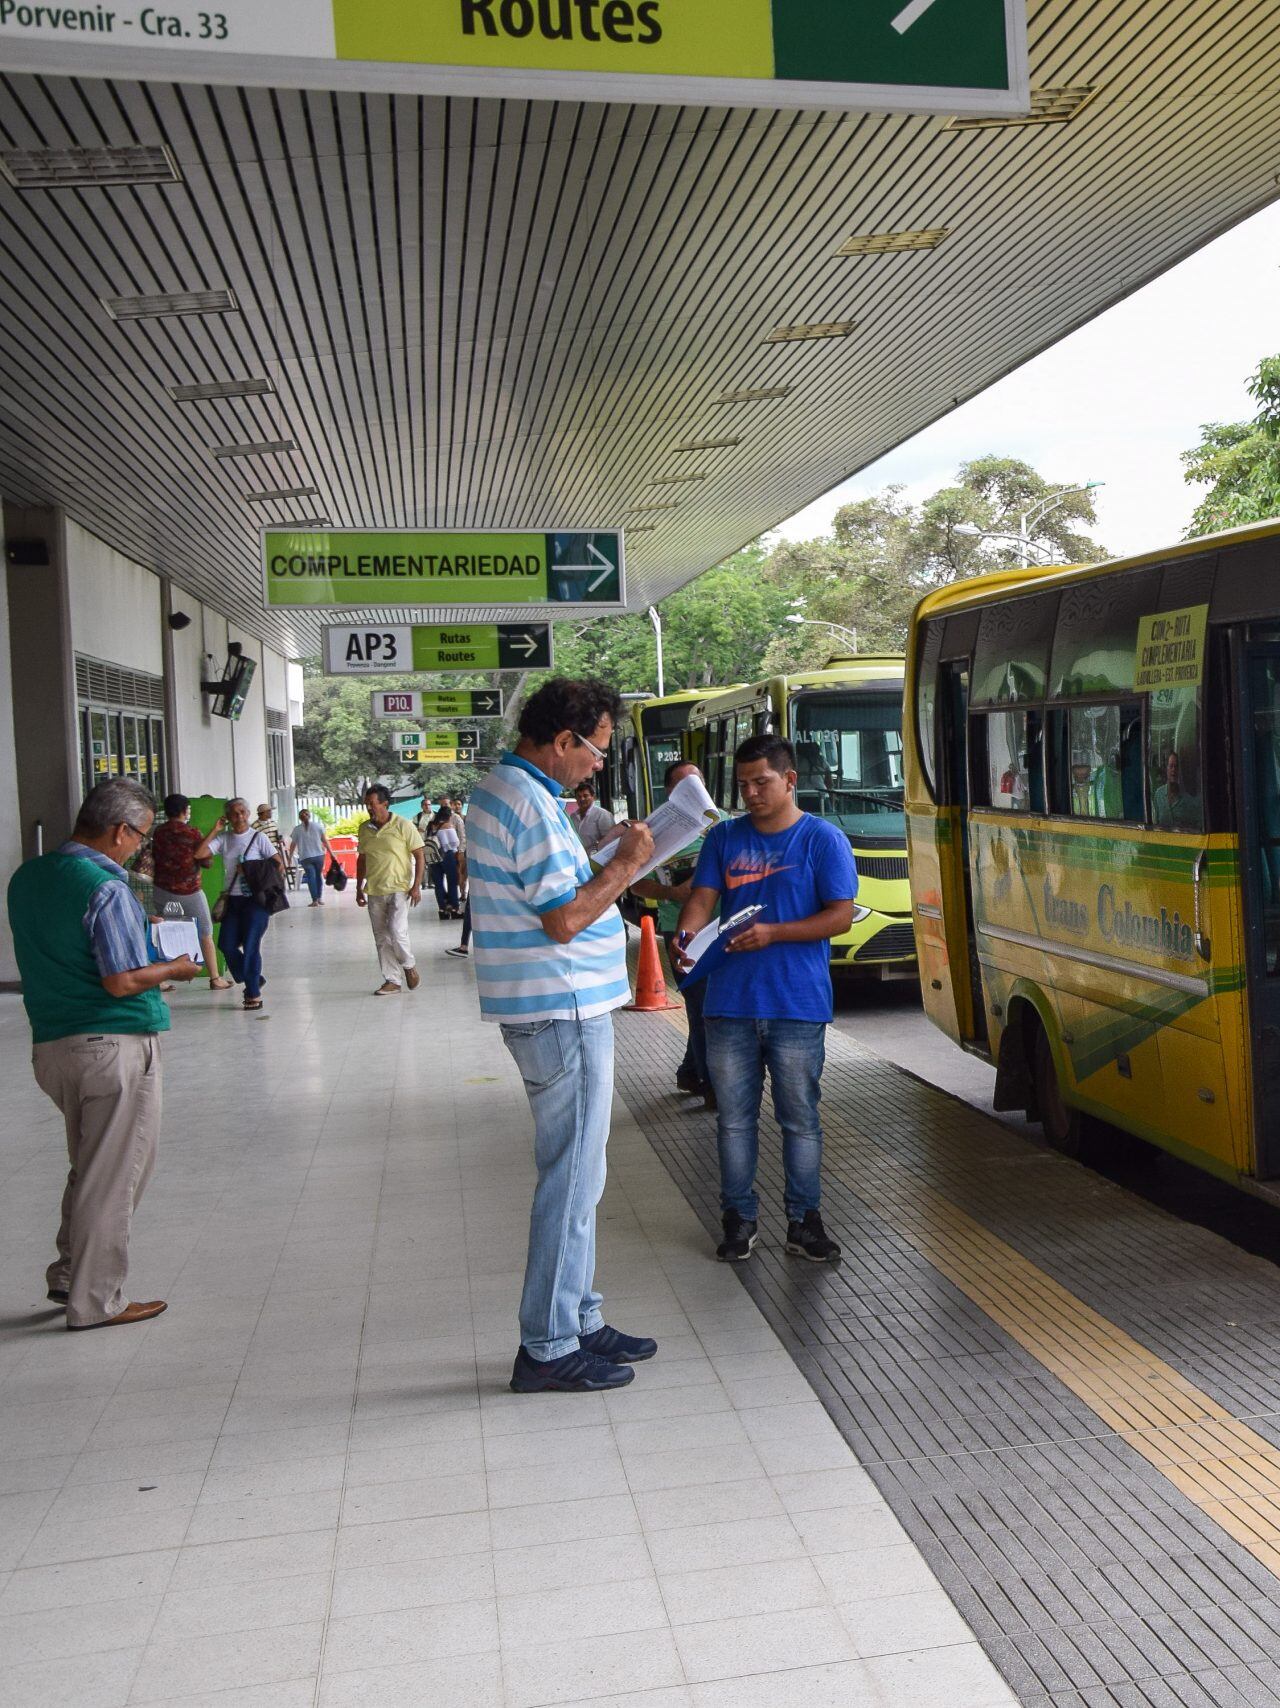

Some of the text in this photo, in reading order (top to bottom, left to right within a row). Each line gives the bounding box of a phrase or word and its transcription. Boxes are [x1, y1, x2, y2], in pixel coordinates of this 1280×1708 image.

[0, 0, 116, 33] Porvenir
[140, 8, 191, 38] Cra.
[198, 13, 229, 40] 33
[460, 0, 663, 45] Routes
[270, 555, 541, 578] COMPLEMENTARIEDAD
[346, 633, 397, 661] AP3
[440, 632, 471, 644] Rutas
[438, 650, 476, 662] Routes
